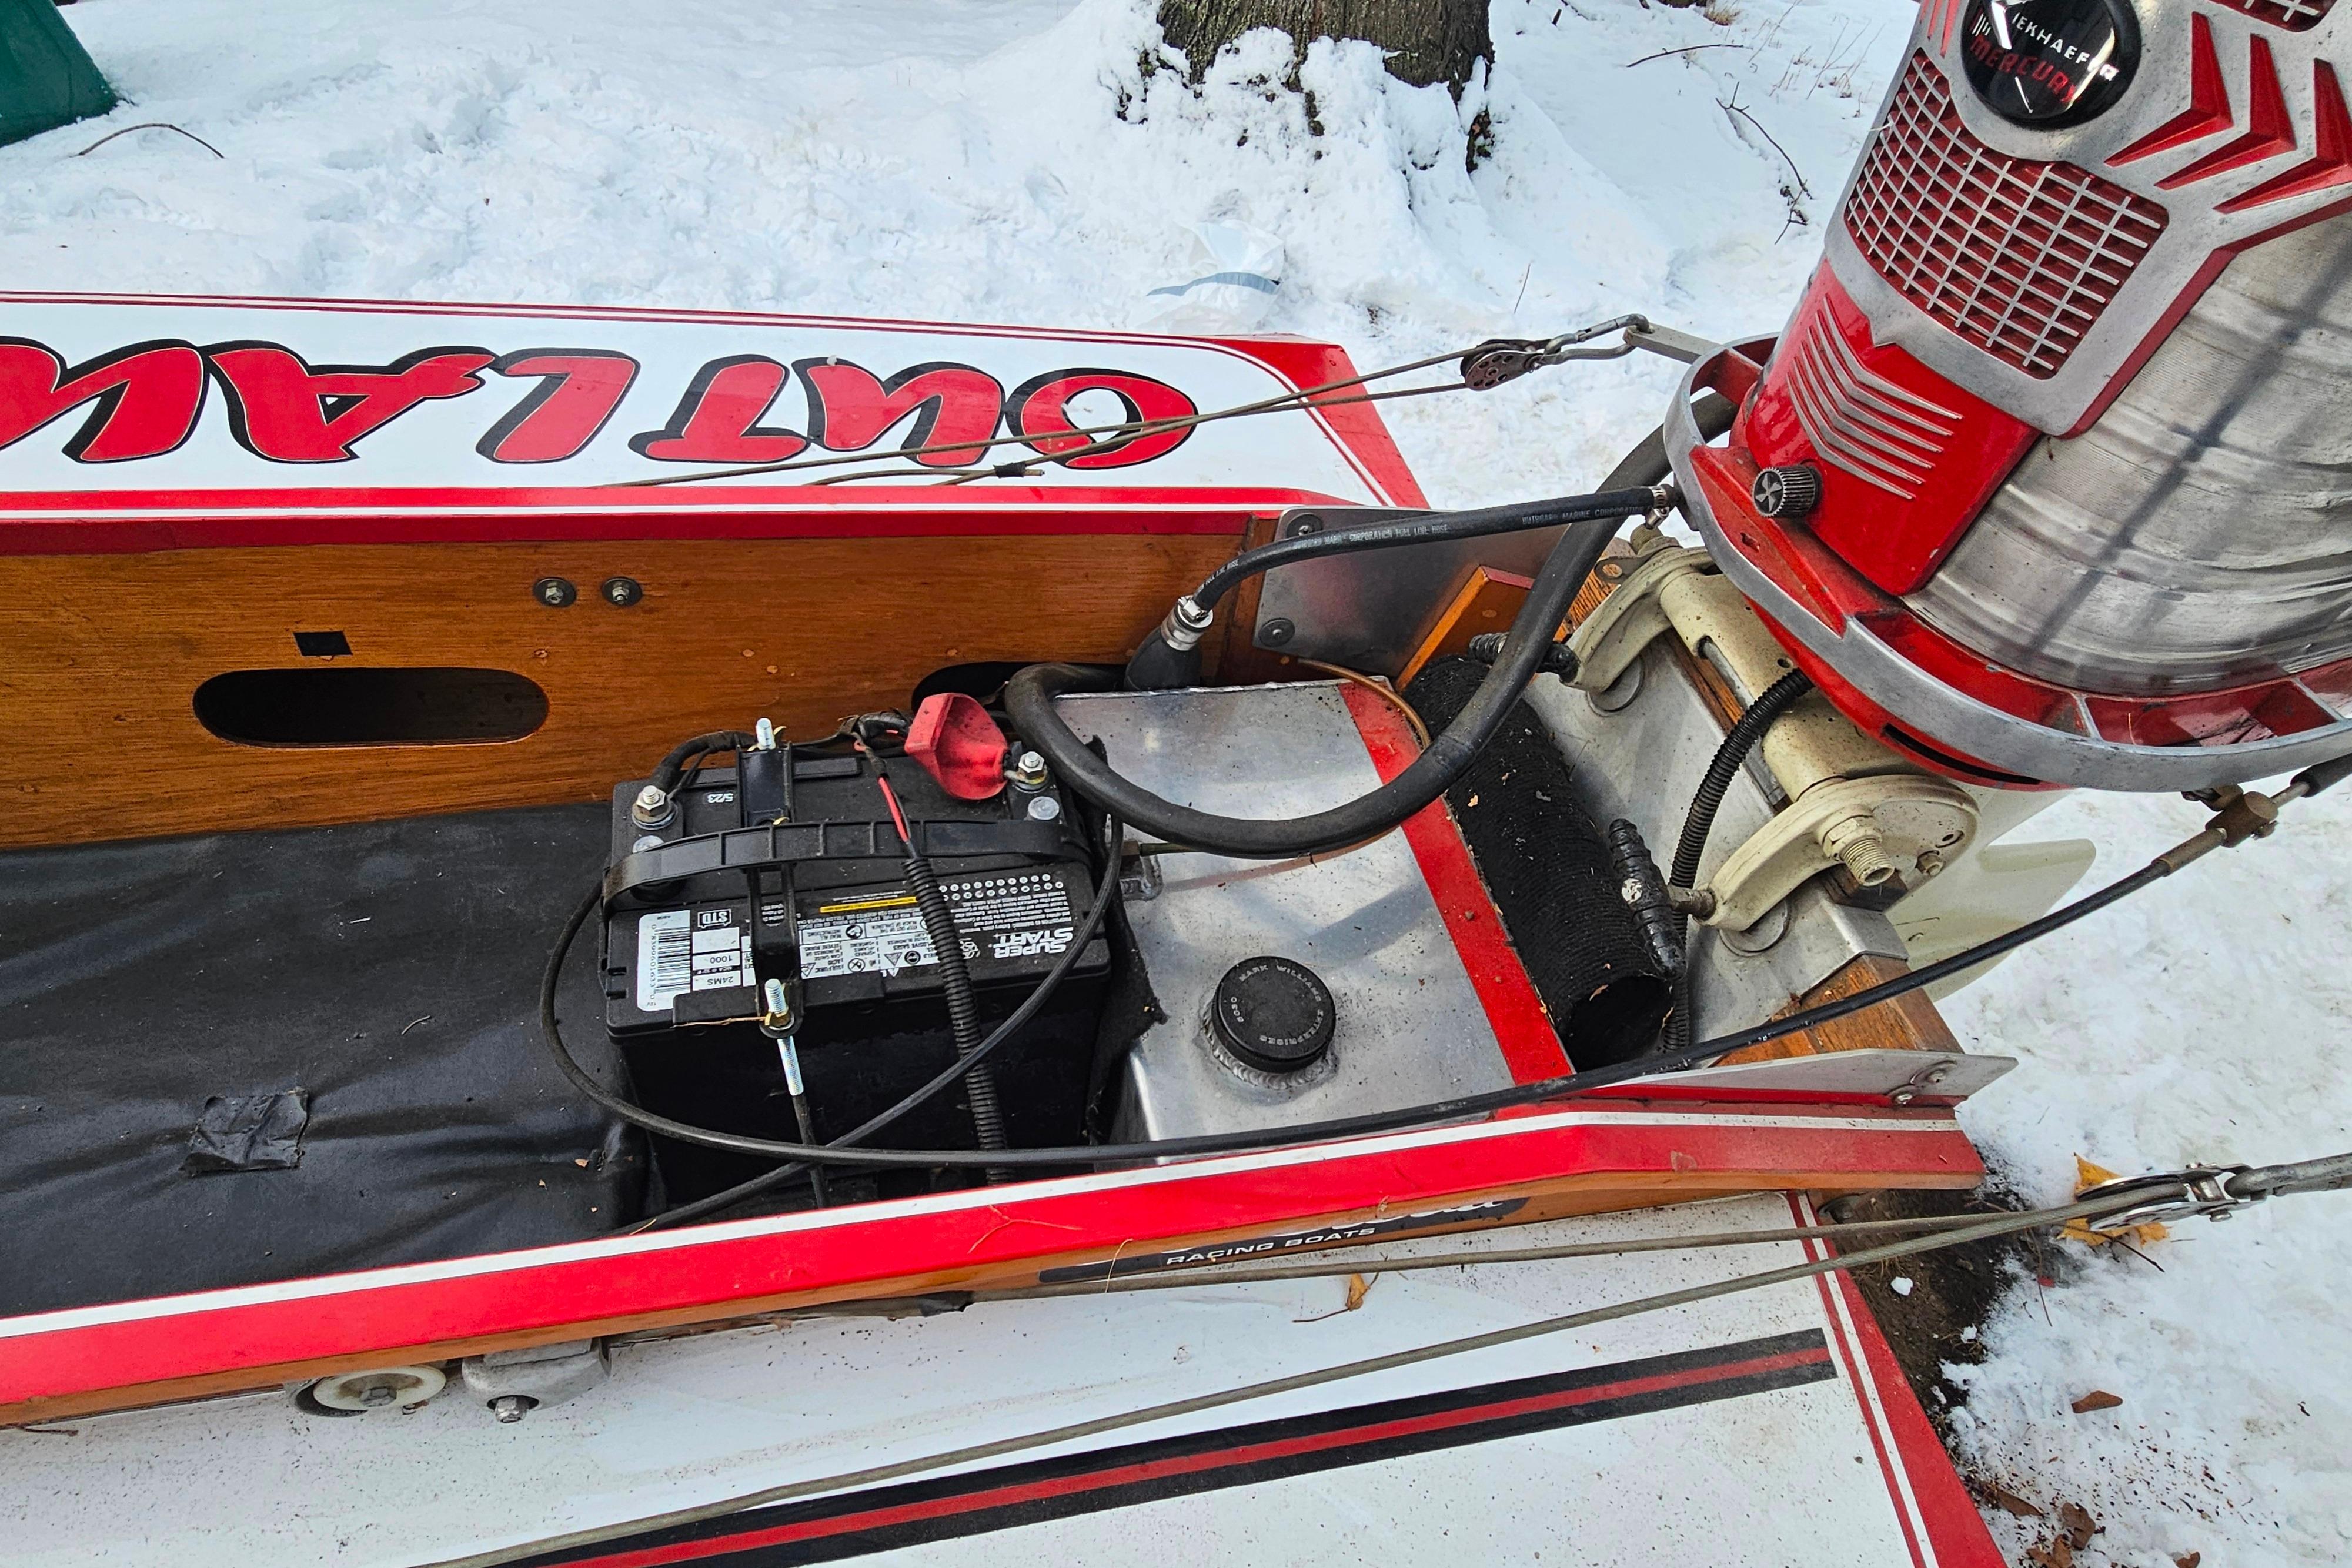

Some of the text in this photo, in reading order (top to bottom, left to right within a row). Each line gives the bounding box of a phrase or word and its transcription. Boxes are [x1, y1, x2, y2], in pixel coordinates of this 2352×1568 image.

[1970, 34, 2083, 103] MERCURY
[1562, 510, 1590, 520] MARINE
[1349, 529, 1392, 541] CORPORATION
[1432, 524, 1448, 533] HOSE
[707, 793, 734, 803] 5/23
[702, 912, 727, 924] STD
[993, 927, 1073, 948] START
[994, 940, 1067, 958] SUPER
[710, 955, 733, 964] 1000
[707, 976, 734, 985] 24MS
[1239, 965, 1324, 1045] MARK WILLIAMS ENTERPRISES
[1167, 1228, 1375, 1265] RACING BOATS
